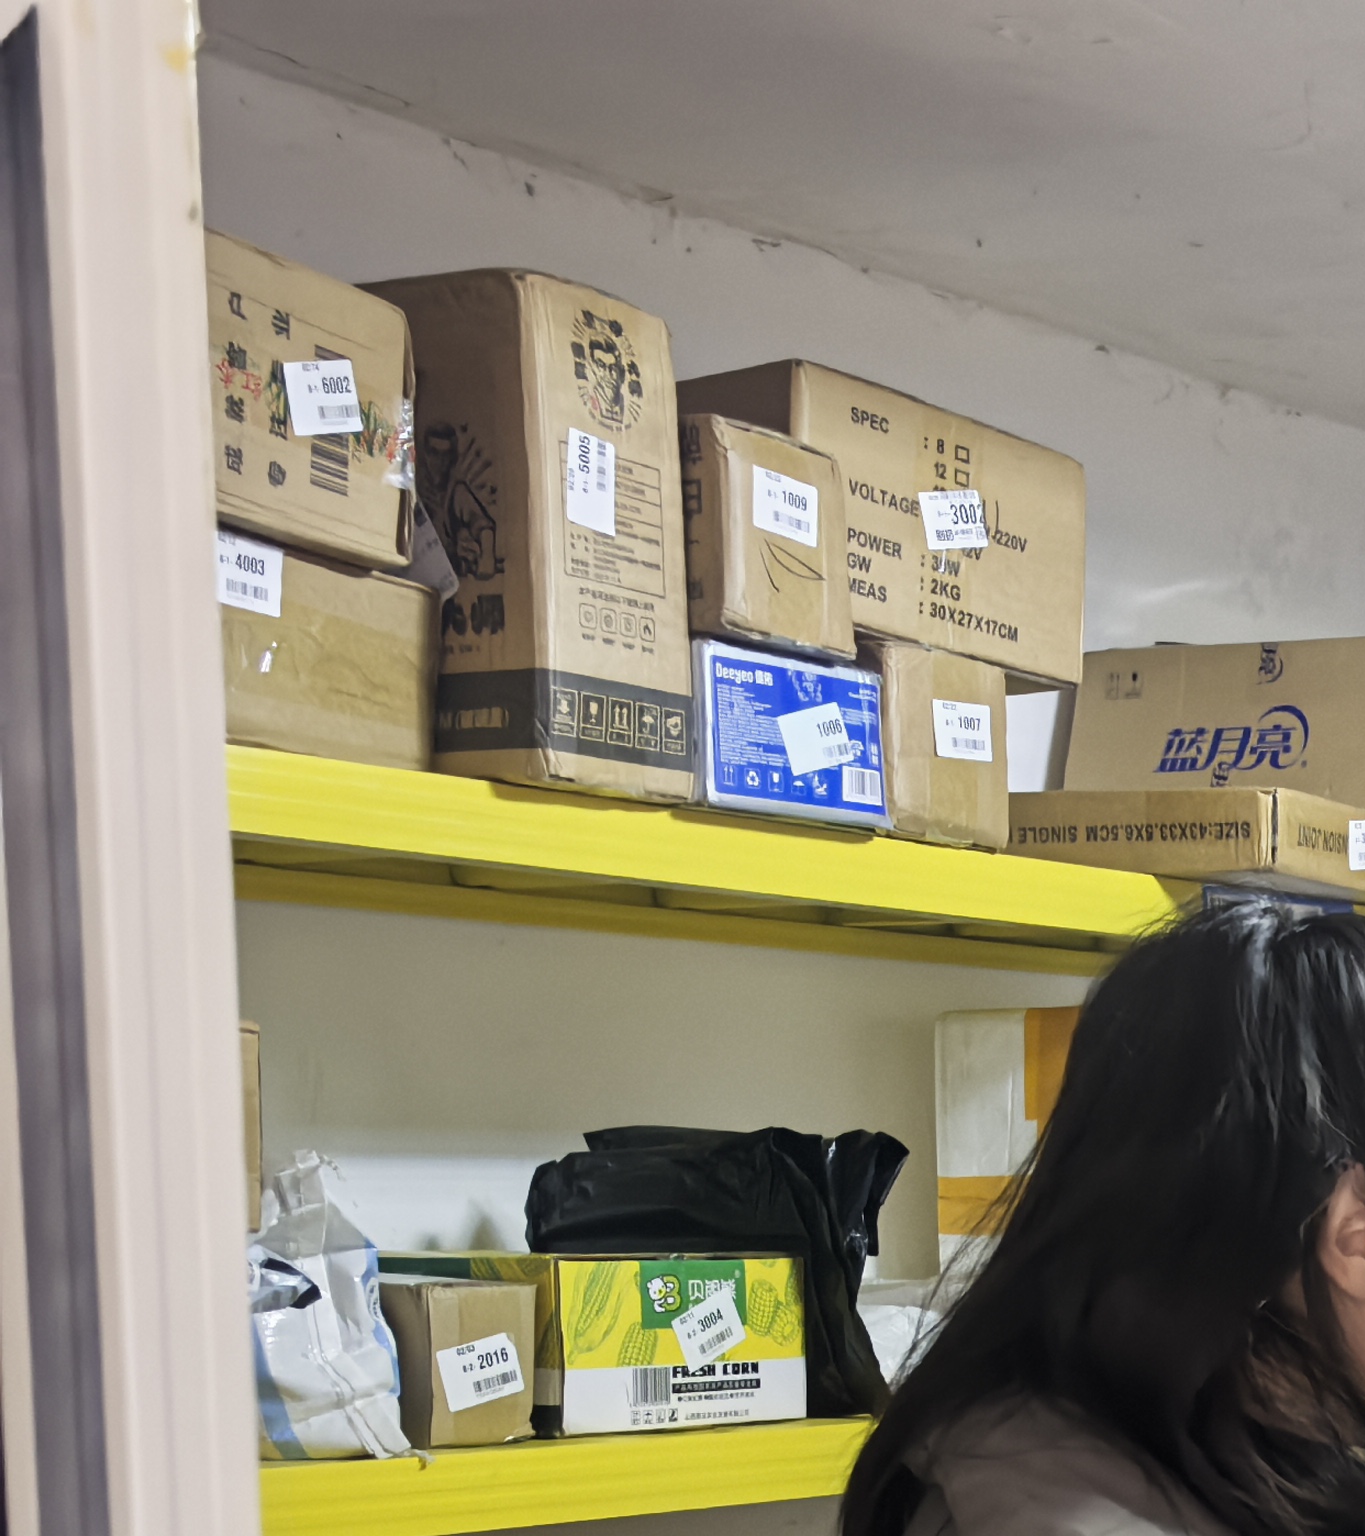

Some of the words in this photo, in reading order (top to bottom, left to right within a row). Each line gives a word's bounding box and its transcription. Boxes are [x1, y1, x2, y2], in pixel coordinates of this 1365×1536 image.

[268, 308, 290, 487] 专注业
[321, 377, 352, 394] 6002
[850, 406, 889, 433] SPEC
[578, 434, 591, 474] 5005
[933, 462, 947, 479] 12
[781, 490, 808, 511] 1009
[848, 478, 920, 518] VOLTAGE
[846, 527, 902, 560] POWER
[235, 553, 265, 576] 4003
[846, 552, 872, 574] GW
[929, 578, 961, 602] 2KG
[847, 578, 888, 602] MEAS
[929, 601, 1019, 642] 30X27X17CM
[816, 718, 843, 738] 1006
[957, 715, 981, 731] 1007
[1153, 715, 1303, 773] 蓝月亮
[1017, 825, 1078, 845] SINGLE
[697, 1308, 724, 1333] 3004
[477, 1347, 509, 1370] 2016
[722, 1361, 760, 1376] CORN
